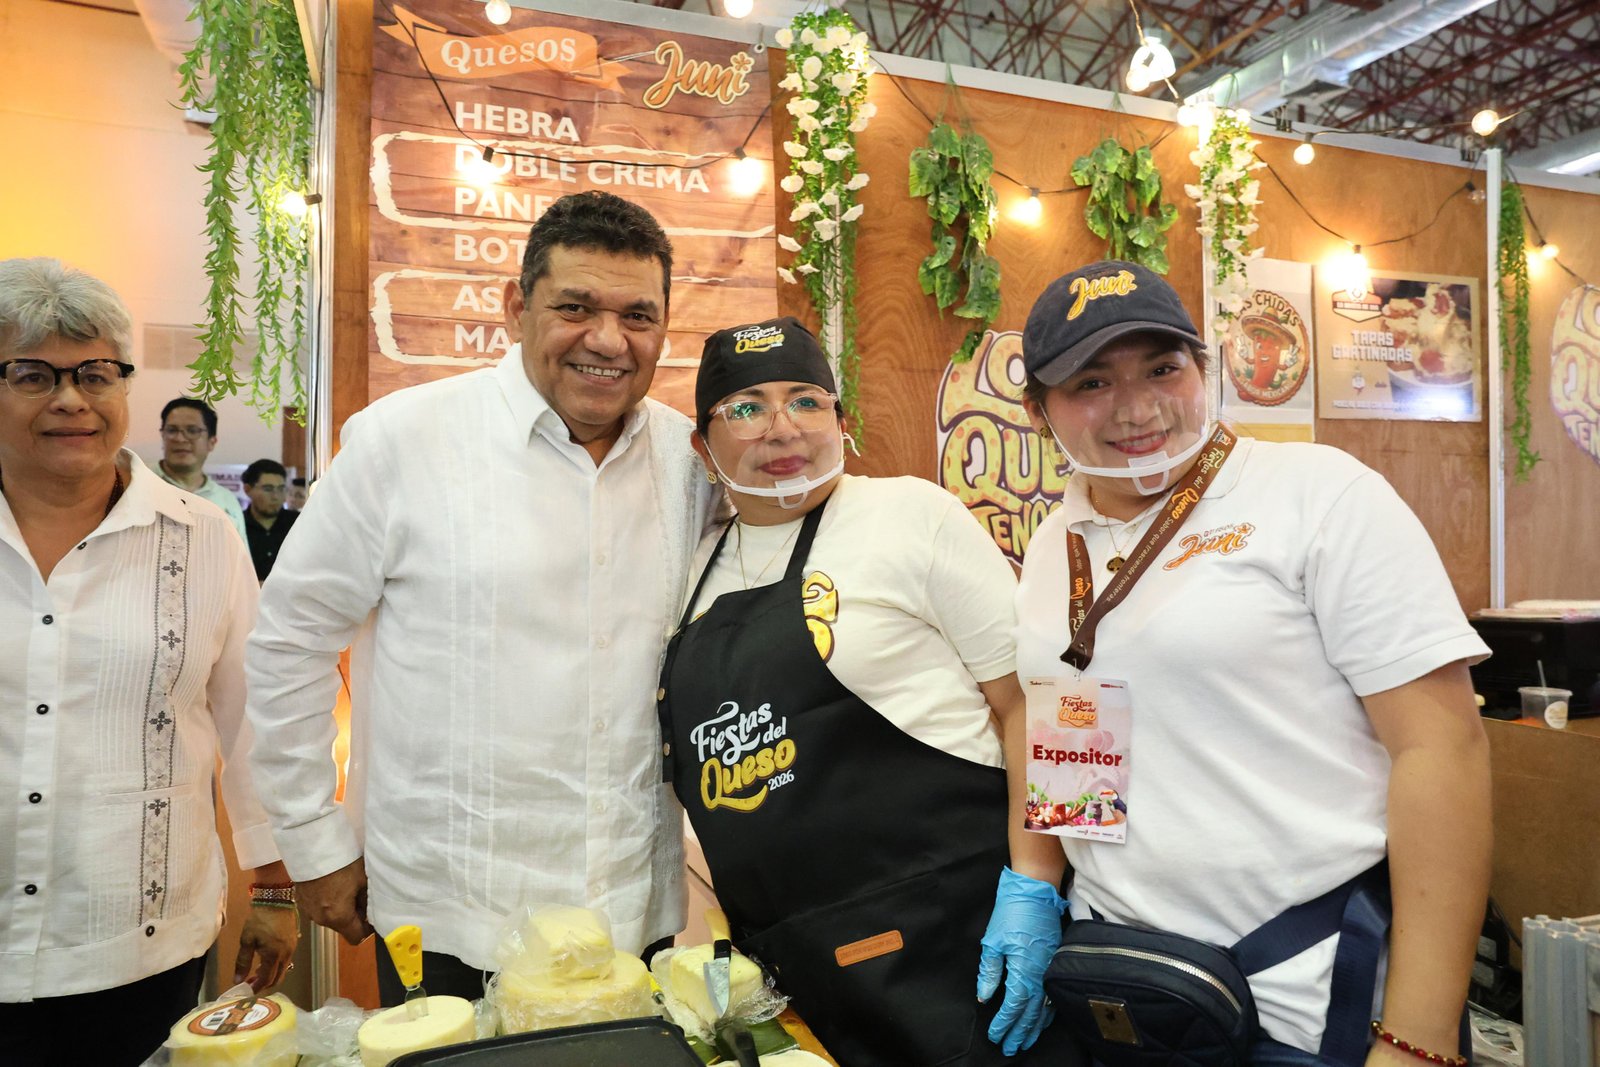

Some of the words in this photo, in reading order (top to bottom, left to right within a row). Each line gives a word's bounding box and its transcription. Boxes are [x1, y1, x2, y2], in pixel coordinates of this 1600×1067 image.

[643, 40, 755, 109] Juni
[455, 101, 580, 142] HEBRA
[454, 145, 577, 184] DOBLE
[587, 160, 710, 193] CREMA
[1066, 270, 1138, 320] Juni
[1255, 294, 1299, 327] CHIDAS
[1351, 330, 1394, 347] TAPAS
[1198, 448, 1225, 474] Fiestas
[1193, 475, 1204, 489] del
[1171, 488, 1200, 519] Queso
[1149, 533, 1160, 546] que
[1159, 516, 1174, 535] Sabor
[1128, 545, 1152, 576] trasciende
[1163, 522, 1256, 571] Juni
[1070, 577, 1091, 599] Queso
[1058, 708, 1097, 727] Queso
[1060, 695, 1093, 713] Fiestas
[690, 701, 773, 766] Fiestas
[763, 716, 787, 744] del
[1033, 744, 1123, 767] Expositor
[700, 738, 797, 813] Queso
[767, 769, 795, 791] 2026
